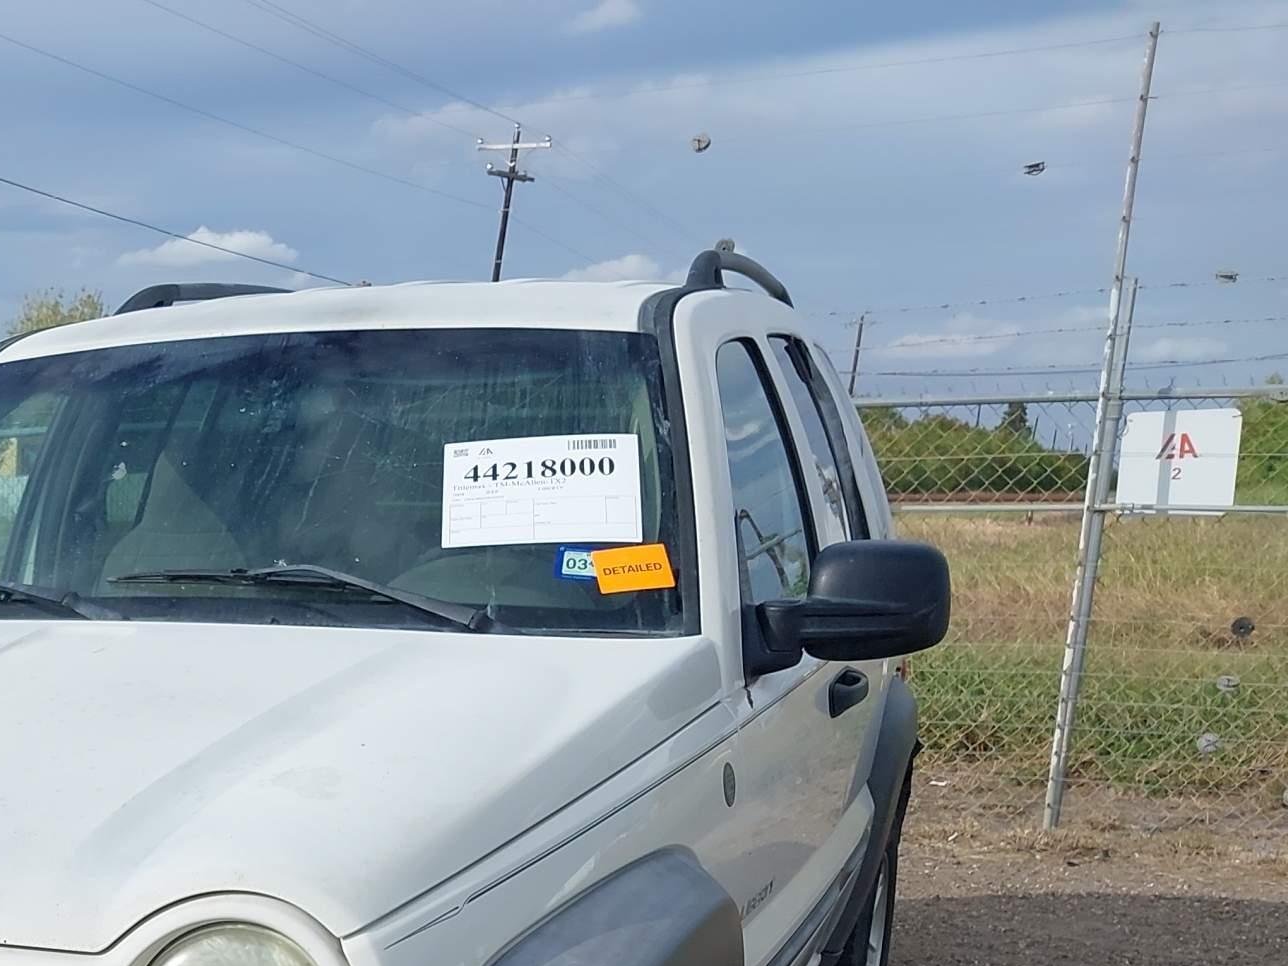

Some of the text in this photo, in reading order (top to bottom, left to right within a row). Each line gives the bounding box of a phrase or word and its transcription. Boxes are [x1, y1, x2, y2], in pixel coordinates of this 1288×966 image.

[463, 456, 615, 482] 44218000
[1171, 467, 1183, 481] 2
[602, 562, 663, 576] DETAILED
